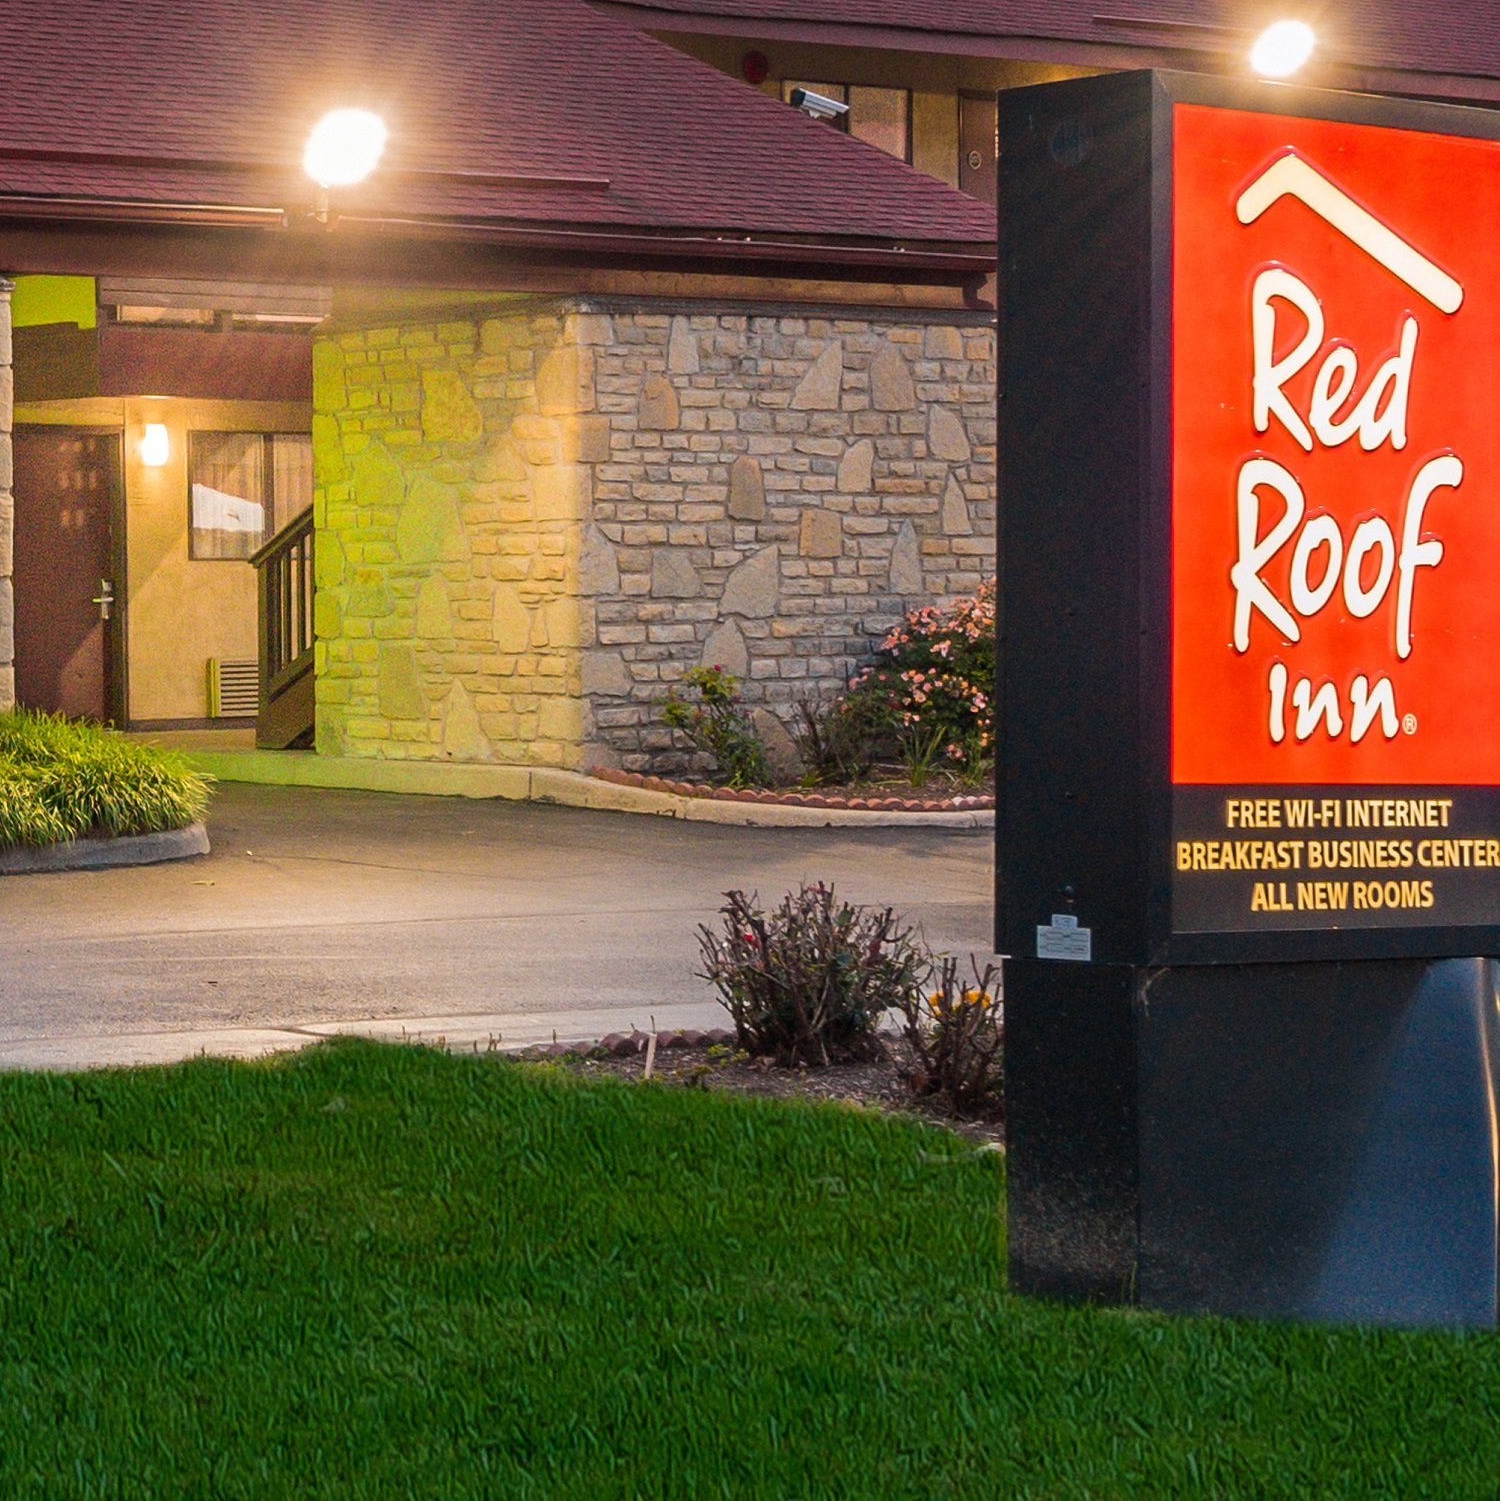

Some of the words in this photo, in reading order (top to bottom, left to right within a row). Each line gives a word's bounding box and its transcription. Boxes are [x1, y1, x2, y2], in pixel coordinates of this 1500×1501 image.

[1252, 267, 1418, 451] Red
[1231, 454, 1463, 659] Roof
[1226, 800, 1281, 829] FREE
[1285, 800, 1342, 828] WI-FI
[1346, 799, 1453, 827] INTERNET
[1176, 841, 1304, 870] BREAKFAST
[1308, 840, 1413, 868] BUSINESS
[1417, 839, 1500, 867] CENTER
[1251, 882, 1293, 911] ALL
[1298, 881, 1349, 910] NEW
[1354, 880, 1434, 909] ROOMS
